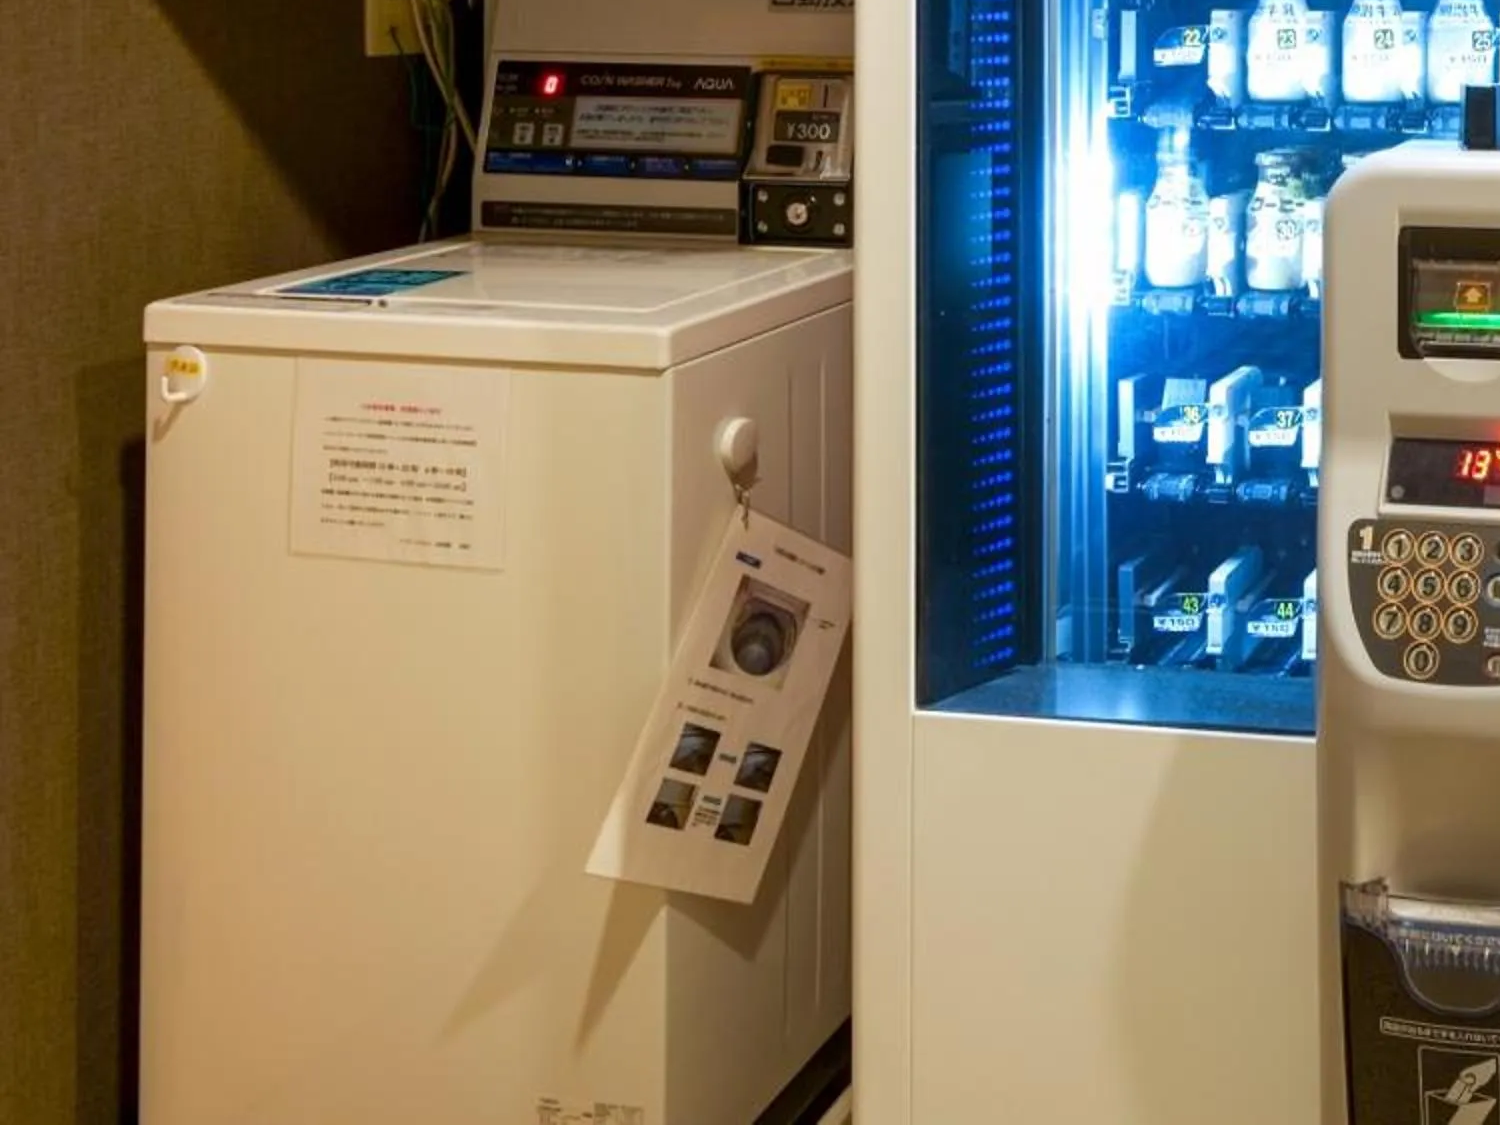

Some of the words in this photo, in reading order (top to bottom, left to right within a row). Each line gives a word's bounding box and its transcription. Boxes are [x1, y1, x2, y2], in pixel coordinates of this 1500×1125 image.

[694, 78, 736, 91] AQUA
[786, 121, 831, 140] ¥300
[1277, 410, 1294, 427] 37
[1359, 526, 1373, 550] 1
[1394, 540, 1403, 558] 1
[1427, 540, 1440, 559] 2
[1461, 542, 1473, 561] 3
[1388, 575, 1401, 593] 4
[1423, 577, 1436, 596] 5
[1457, 578, 1470, 597] 6
[1183, 596, 1200, 612] 43
[1277, 602, 1295, 617] 44
[1385, 611, 1398, 630] 7
[1419, 612, 1432, 631] 8
[1454, 614, 1466, 633] 9
[1417, 650, 1429, 668] 0
